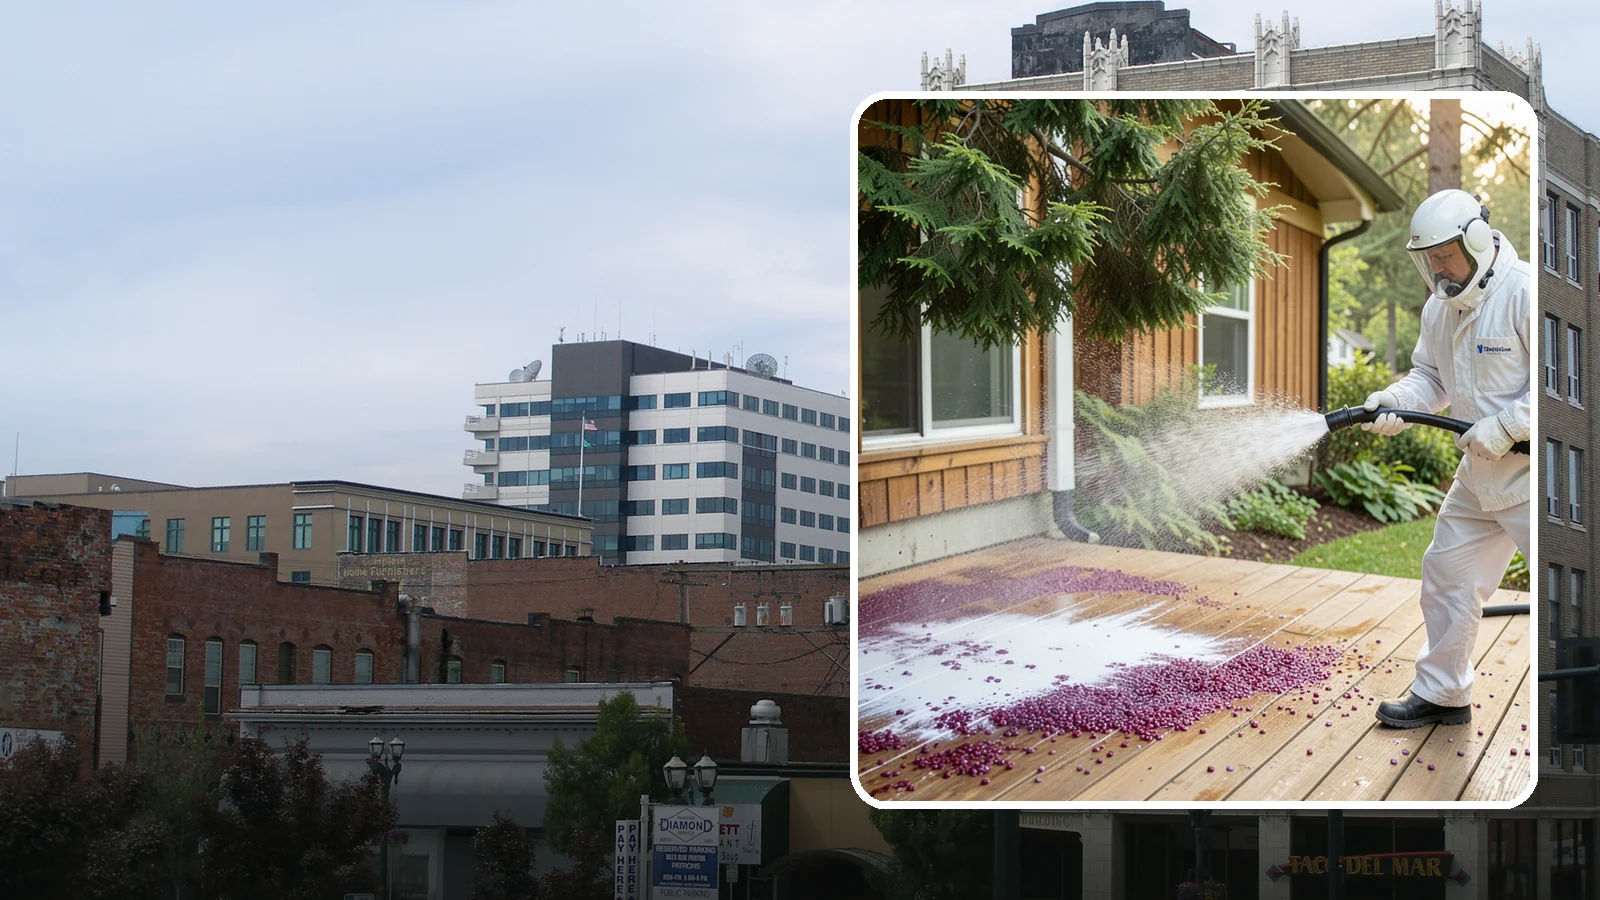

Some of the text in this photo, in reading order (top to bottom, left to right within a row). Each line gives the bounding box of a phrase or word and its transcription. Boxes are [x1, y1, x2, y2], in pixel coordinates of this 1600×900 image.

[343, 566, 428, 577] Home Furnishers
[660, 818, 713, 833] DIAMOND
[1021, 815, 1070, 828] BUILDING
[656, 845, 716, 854] RESERVED PARKING
[617, 825, 625, 893] PAY HERE
[627, 825, 637, 893] PAY HERE
[721, 851, 739, 861] Soup
[671, 862, 701, 870] PATRONS
[1345, 855, 1386, 876] DEL
[1391, 857, 1443, 877] MAR
[660, 888, 710, 898] PUBLIC PARKING
